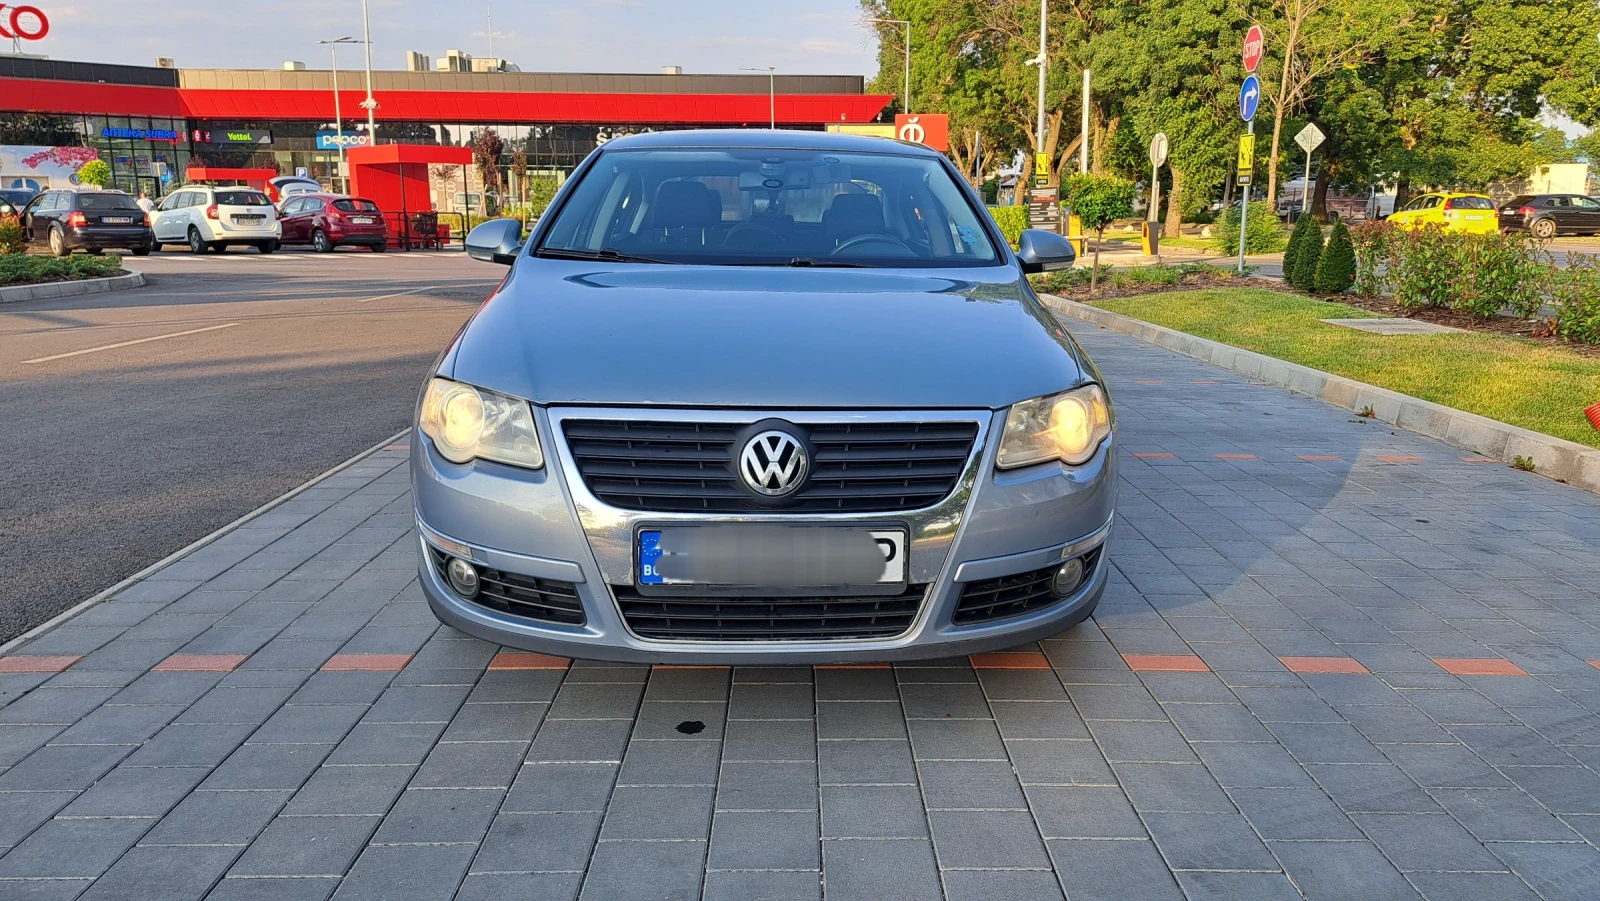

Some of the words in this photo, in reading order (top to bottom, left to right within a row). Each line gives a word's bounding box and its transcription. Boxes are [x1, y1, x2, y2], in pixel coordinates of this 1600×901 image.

[1245, 39, 1260, 59] STOP
[145, 129, 177, 139] SUBRA
[322, 135, 367, 146] pepco
[741, 431, 807, 495] VW
